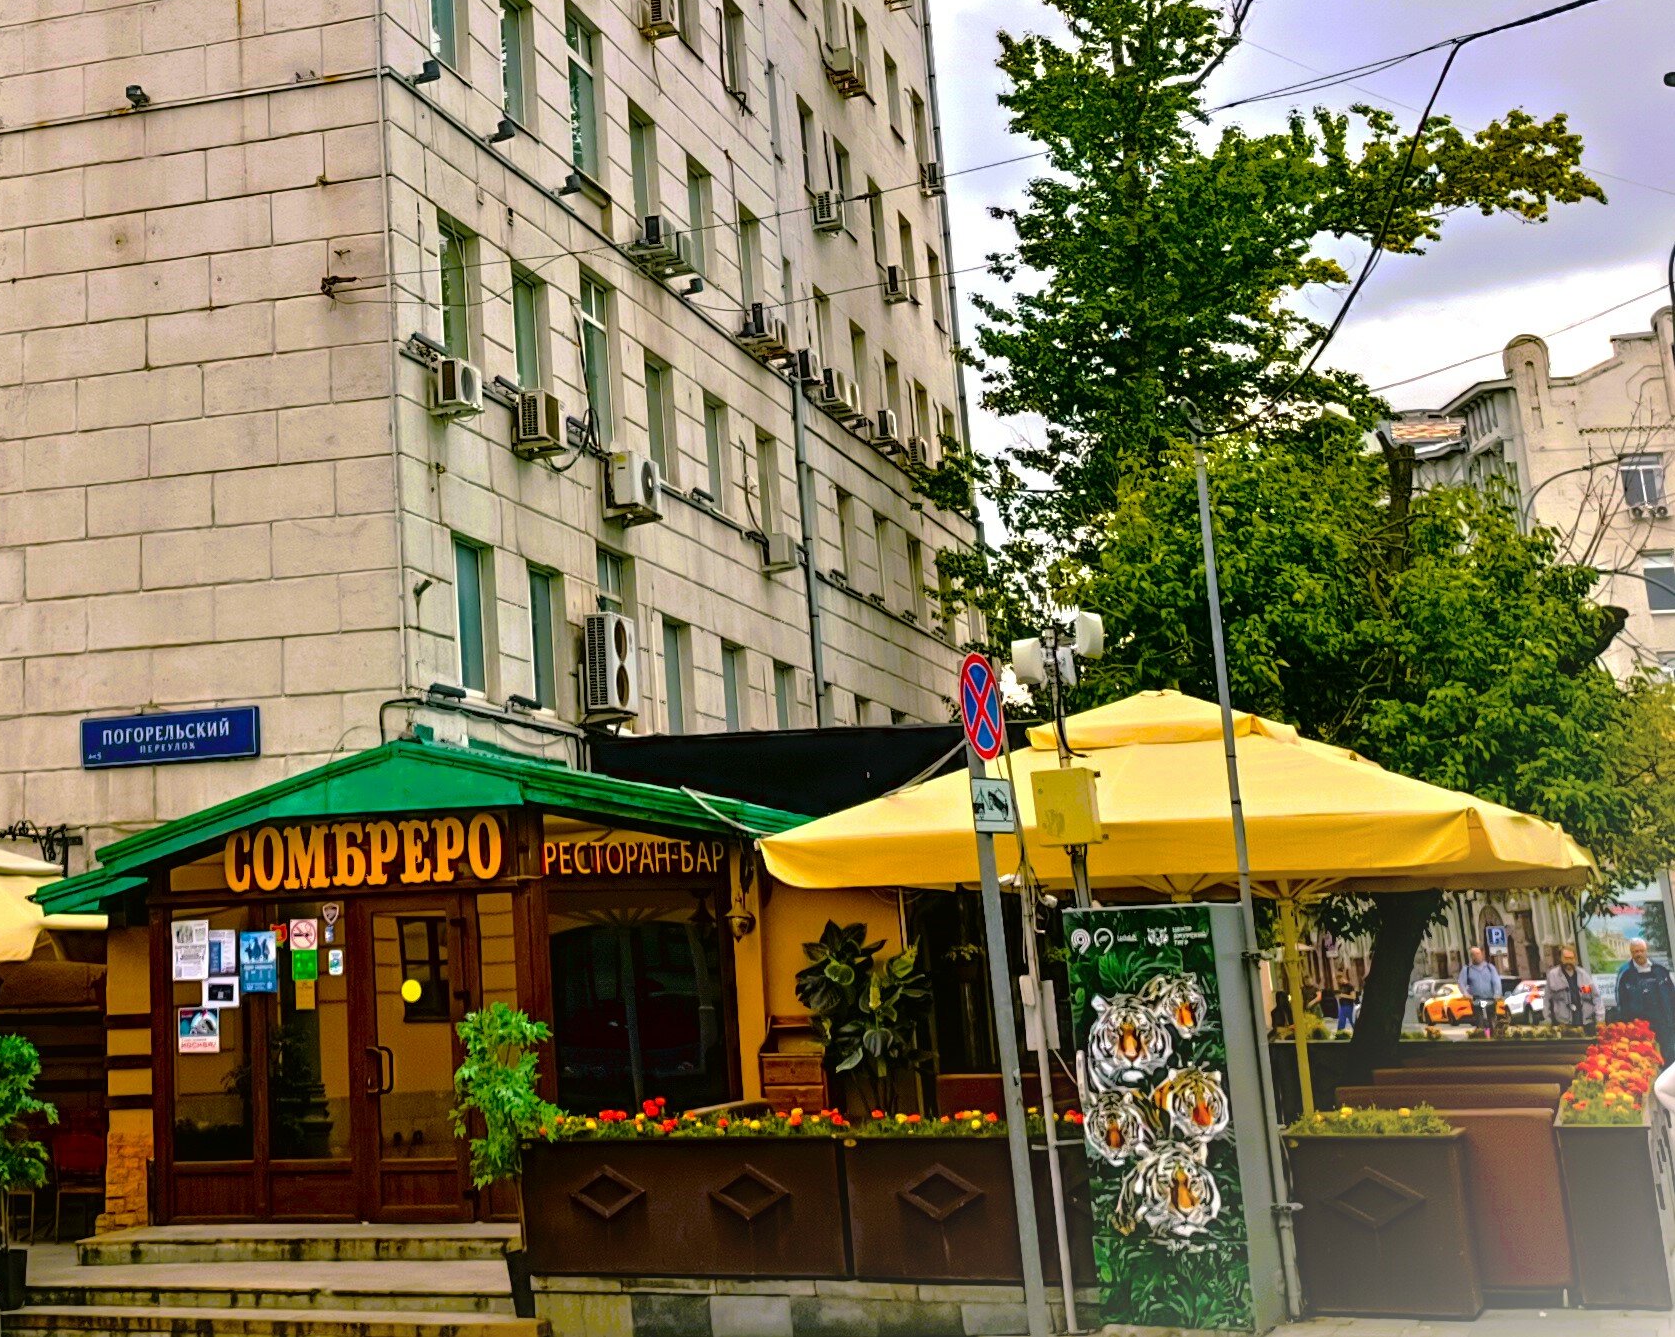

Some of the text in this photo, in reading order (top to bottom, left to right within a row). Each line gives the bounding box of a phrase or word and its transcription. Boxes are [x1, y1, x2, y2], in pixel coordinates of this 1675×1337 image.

[102, 717, 230, 746] ПОГОРЕЛЬСКИЙ
[139, 740, 196, 754] ПЕРЕУЛОК
[224, 812, 504, 892] СОМБРЕРО
[544, 839, 724, 875] РЕСТОРАН-БАР
